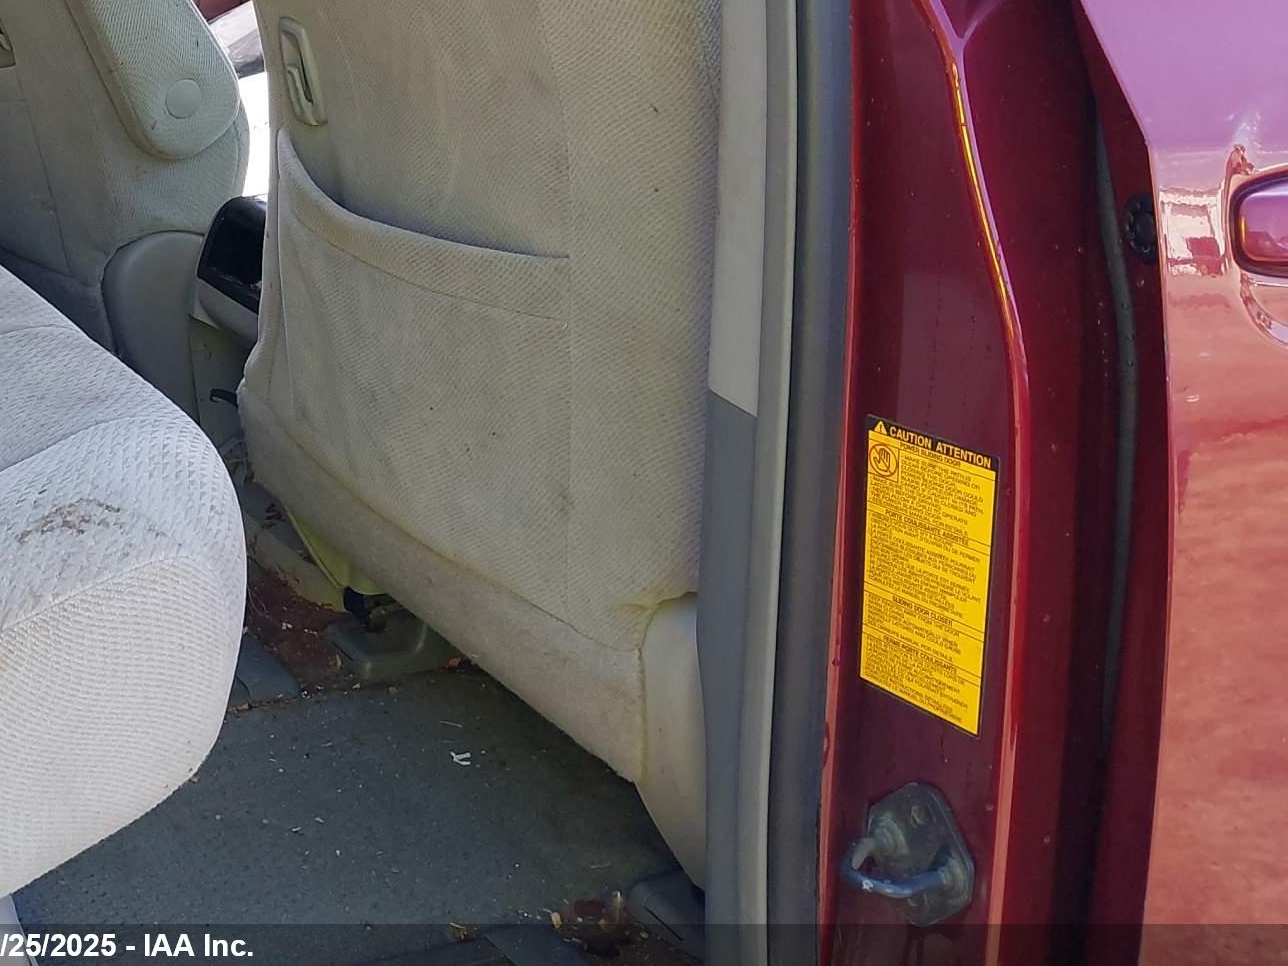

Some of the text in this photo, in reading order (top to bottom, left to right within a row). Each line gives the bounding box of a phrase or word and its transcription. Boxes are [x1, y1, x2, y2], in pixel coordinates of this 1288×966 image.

[889, 425, 991, 468] CAUTION ATTENTION
[900, 442, 960, 467] POWER SLIDING DOOR
[892, 595, 912, 609] SLIDING
[913, 604, 929, 616] DOOR
[930, 611, 952, 626] CLOSER
